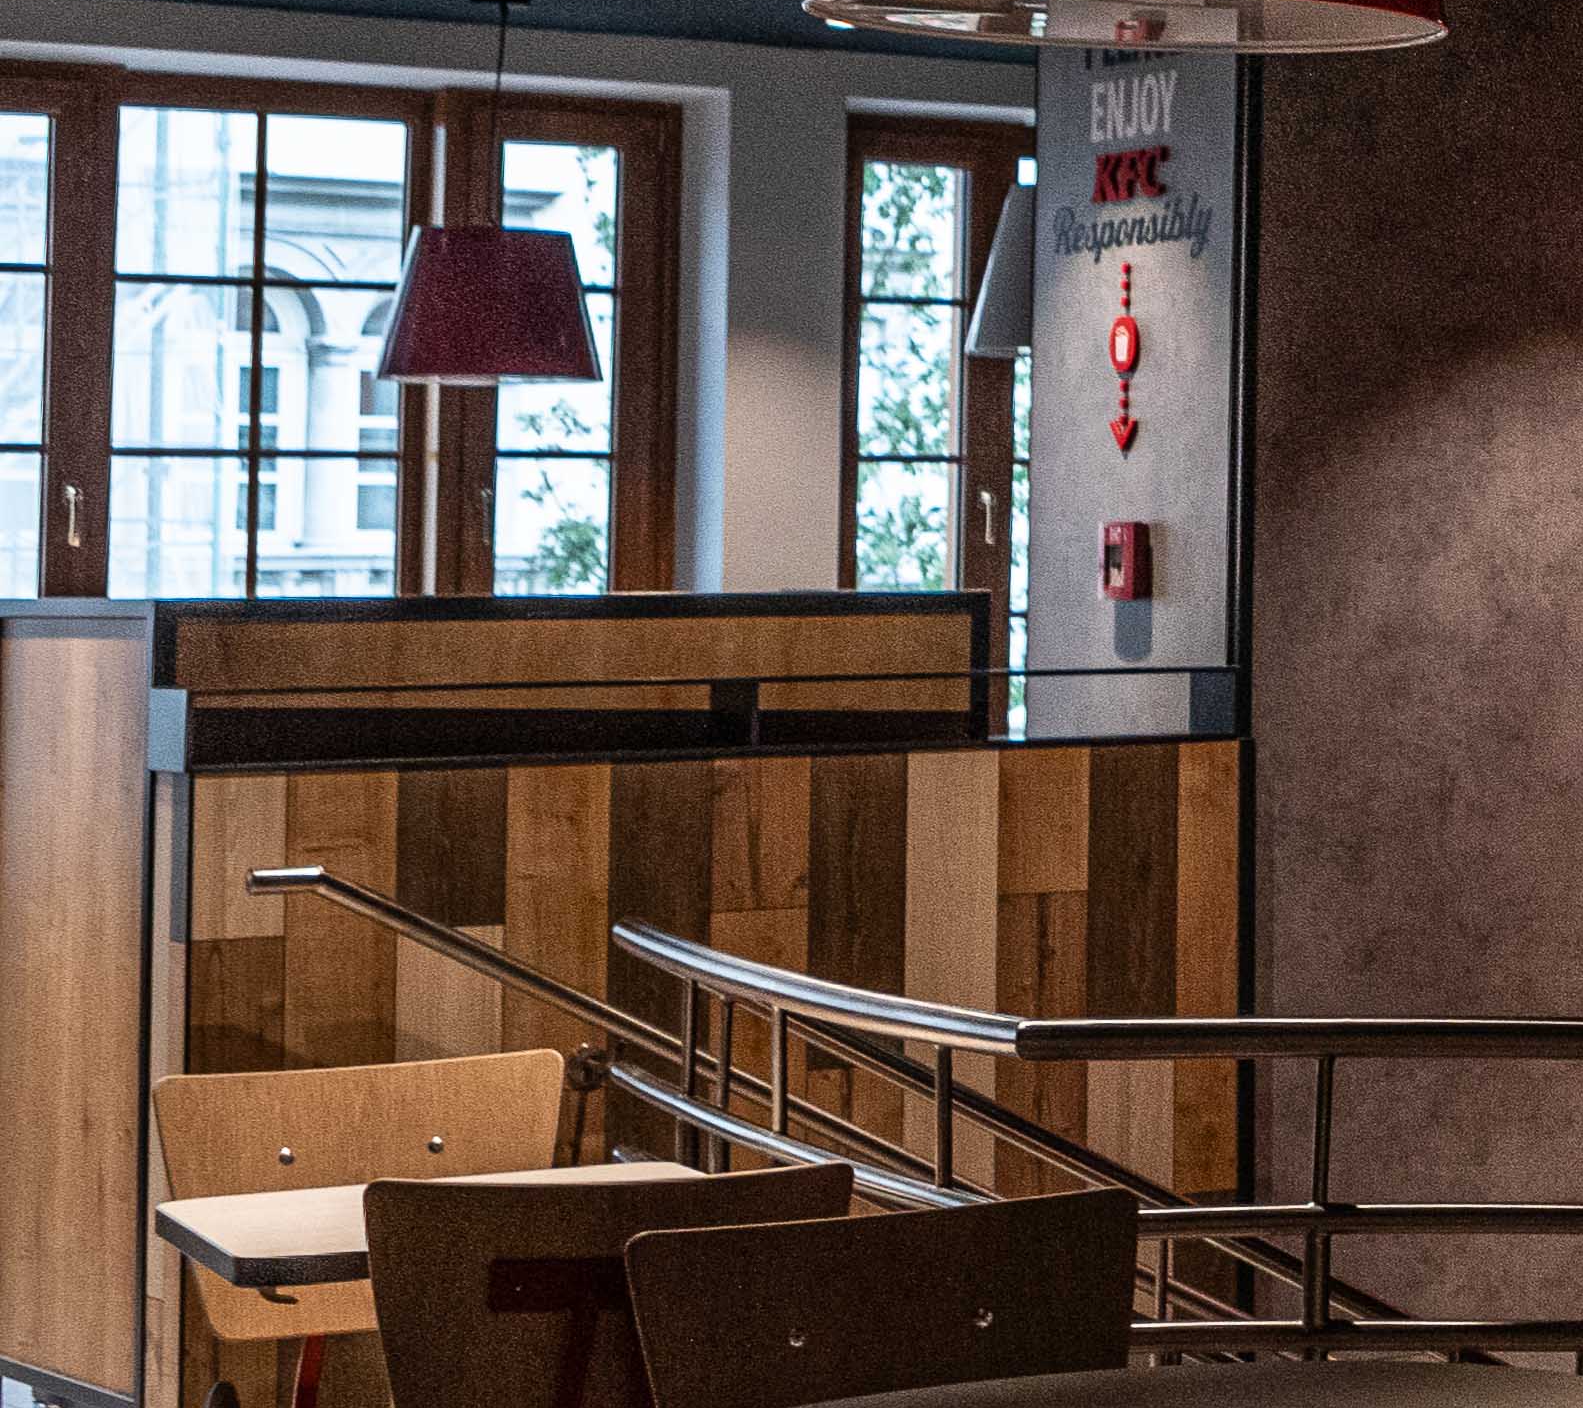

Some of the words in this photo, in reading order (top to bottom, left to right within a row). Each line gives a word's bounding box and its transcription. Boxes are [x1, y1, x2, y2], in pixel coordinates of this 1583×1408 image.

[1090, 69, 1178, 143] ENJOY
[1091, 146, 1171, 204] KFC
[1053, 192, 1212, 262] Responsibly
